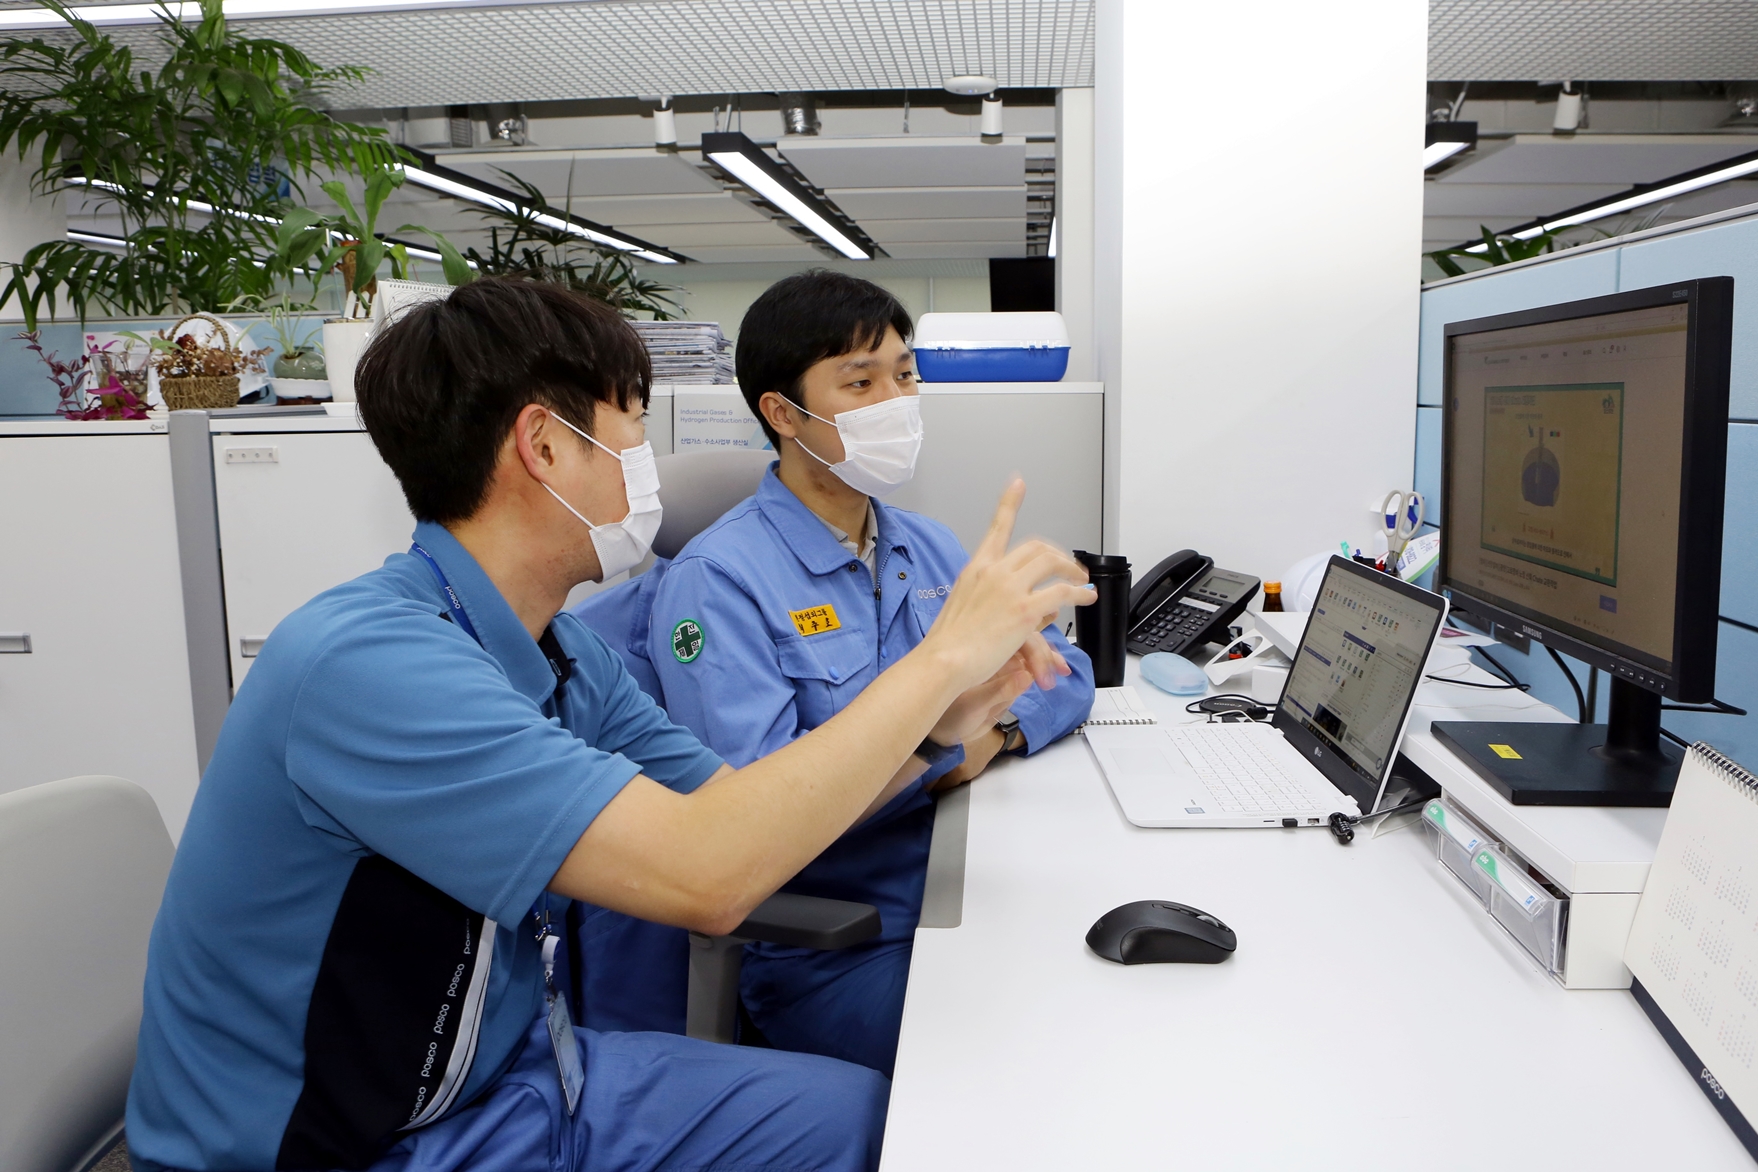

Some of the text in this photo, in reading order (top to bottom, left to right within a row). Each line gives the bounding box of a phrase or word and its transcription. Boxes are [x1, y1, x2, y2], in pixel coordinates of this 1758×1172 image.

[680, 416, 709, 424] Hydrogen
[1522, 624, 1542, 640] SAMSUNG
[447, 963, 465, 997] posco
[433, 1003, 450, 1034] posco
[421, 1042, 437, 1077] posco
[1700, 1067, 1725, 1099] posco
